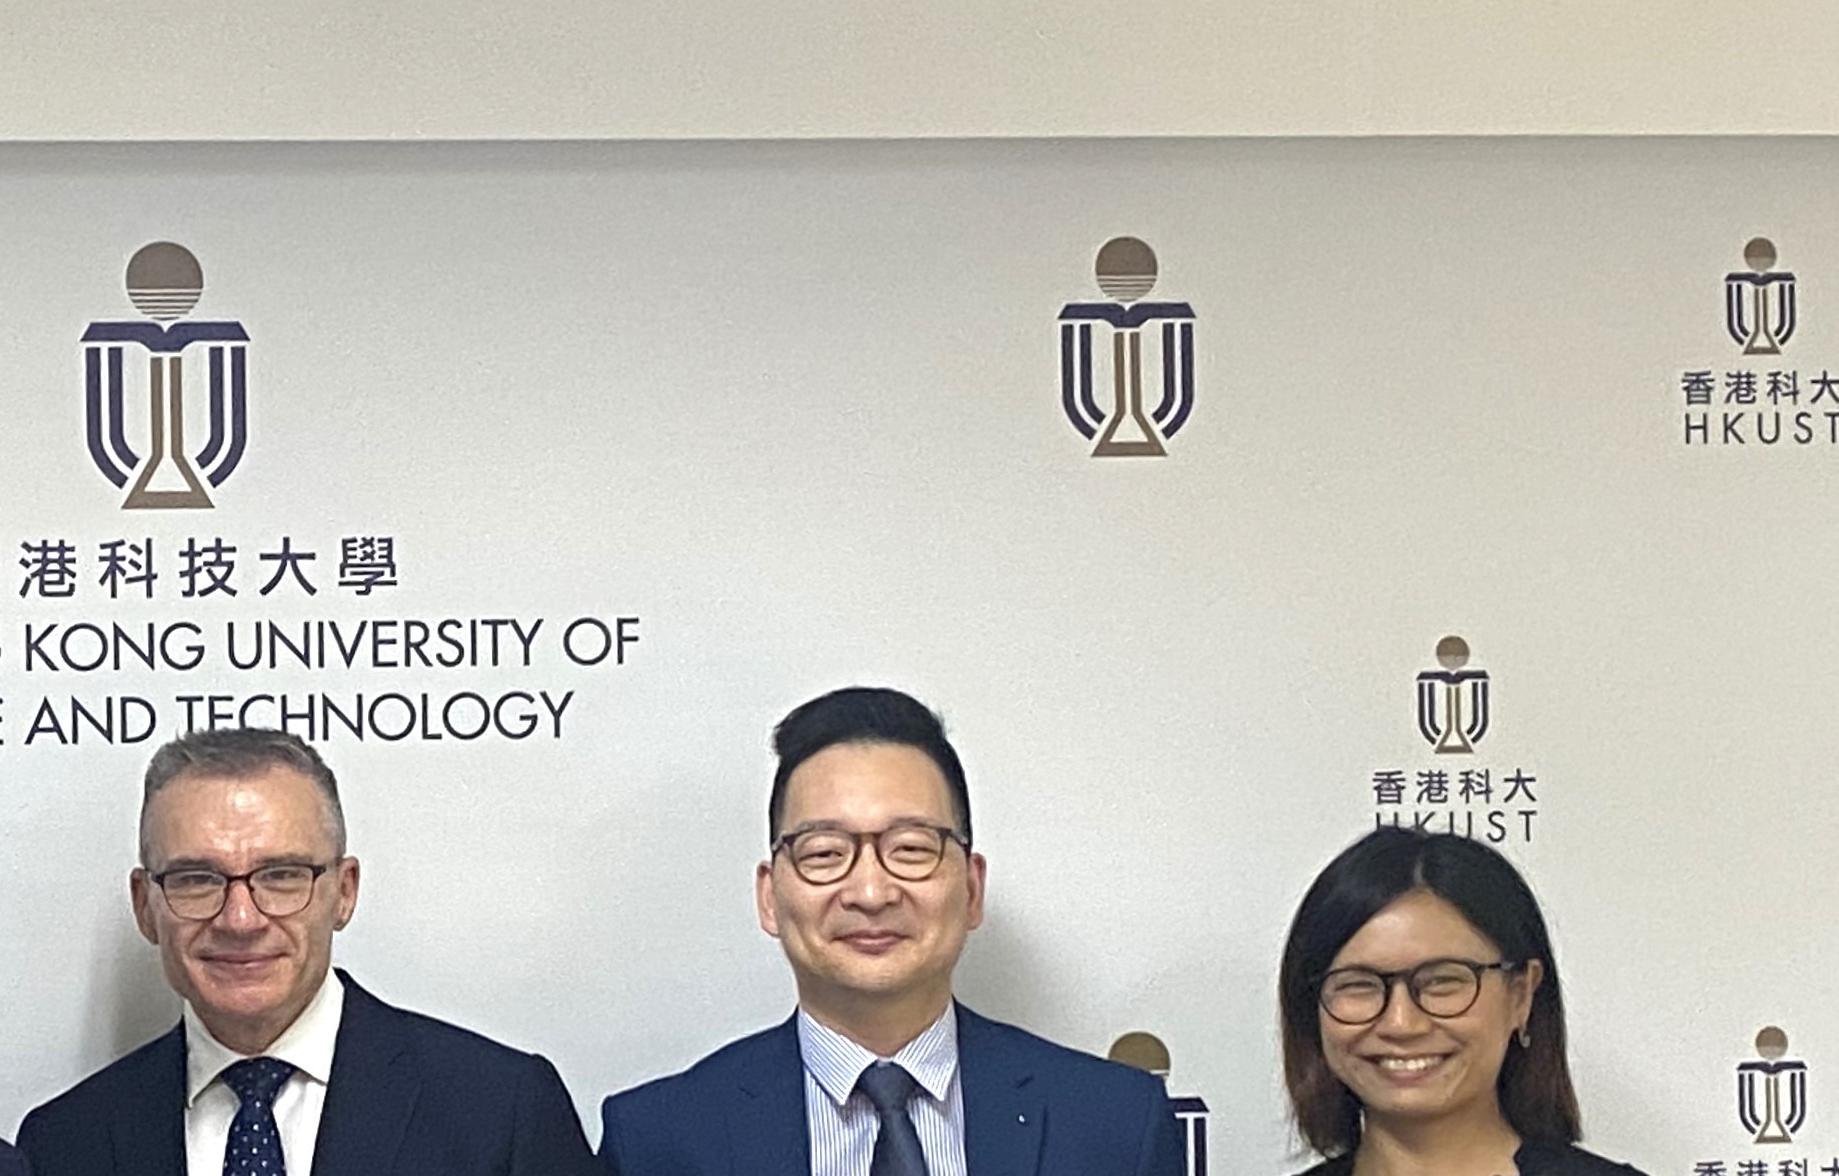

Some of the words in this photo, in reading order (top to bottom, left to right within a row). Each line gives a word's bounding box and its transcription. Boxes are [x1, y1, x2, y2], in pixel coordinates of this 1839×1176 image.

[1680, 370, 1839, 405] 香港科大
[1684, 411, 1839, 445] HKUST
[25, 621, 205, 672] KONG
[227, 618, 544, 670] UNIVERSITY
[563, 616, 640, 666] OF
[24, 695, 157, 747] AND
[175, 690, 574, 742] TECHNOLOGY
[1372, 767, 1537, 805] 香港科大
